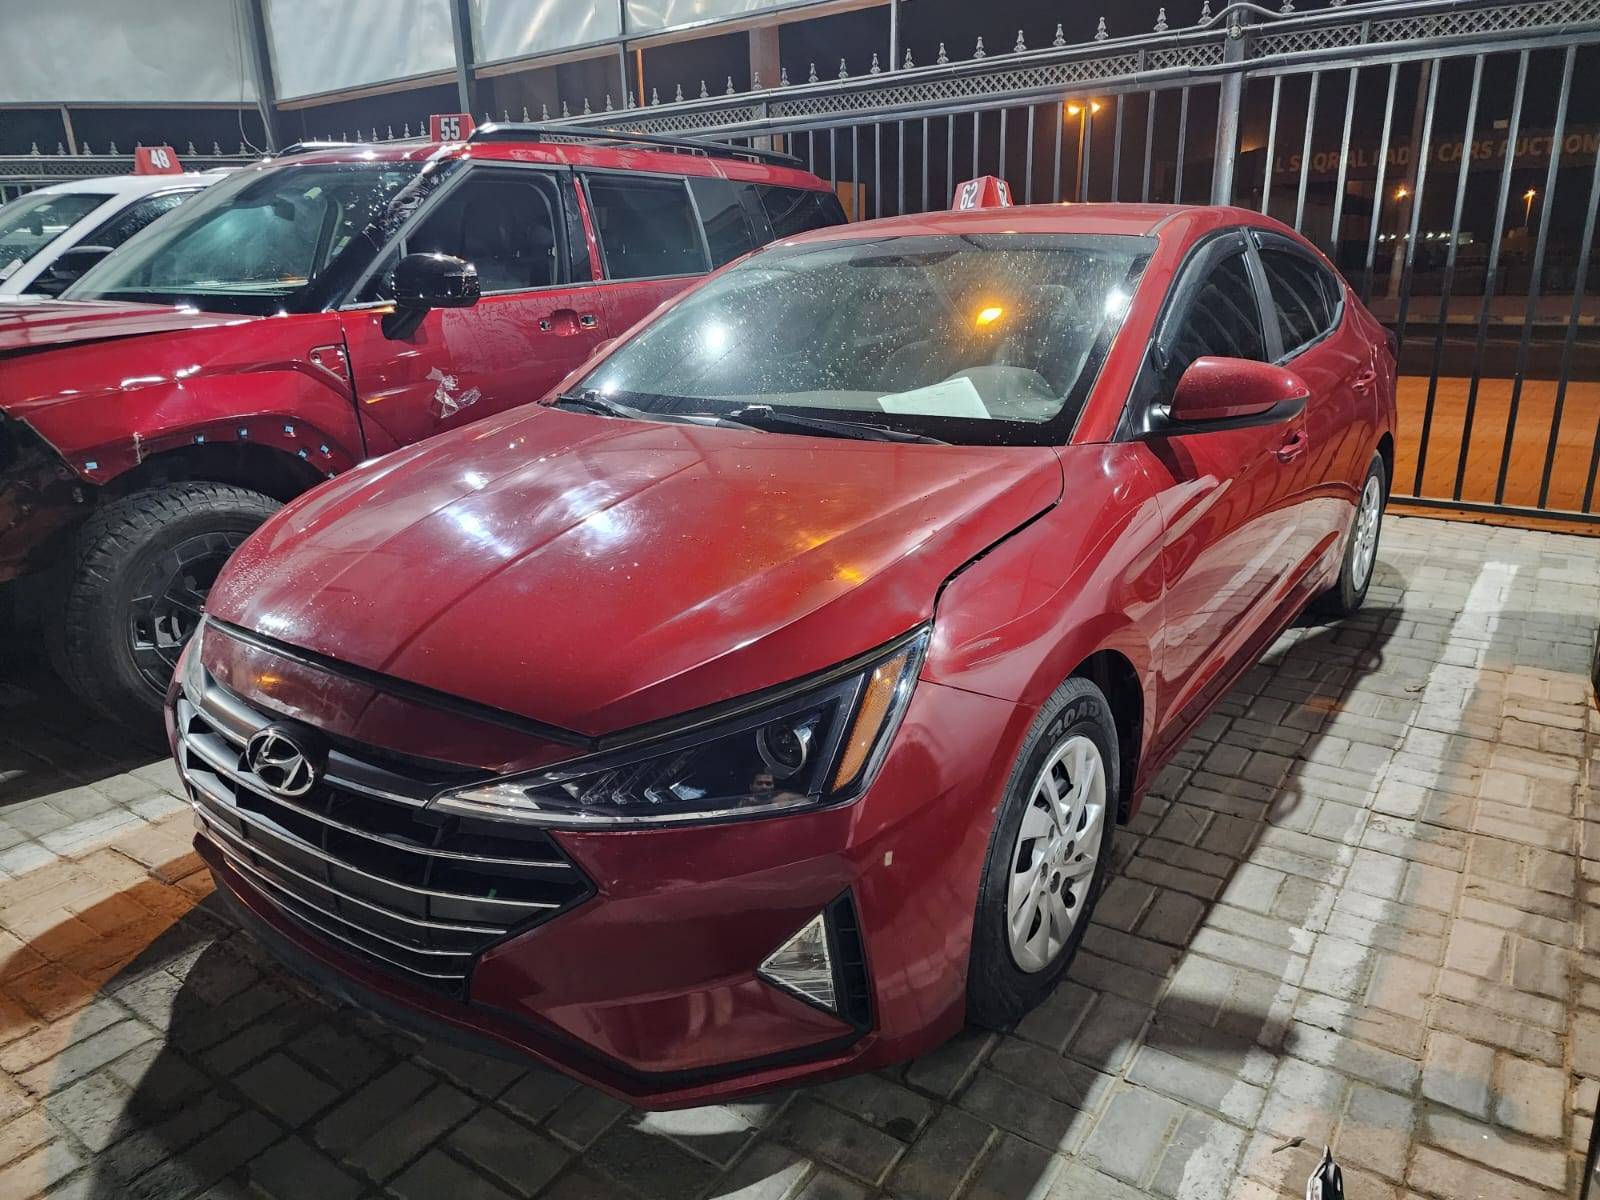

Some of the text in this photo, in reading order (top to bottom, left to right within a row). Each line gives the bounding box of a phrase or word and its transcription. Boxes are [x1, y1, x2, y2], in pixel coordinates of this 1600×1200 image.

[440, 117, 460, 141] 55
[150, 149, 170, 169] 48
[1287, 152, 1341, 174] SQR
[1438, 140, 1494, 162] CARS
[1497, 133, 1600, 158] AUCTON
[960, 182, 979, 210] 62
